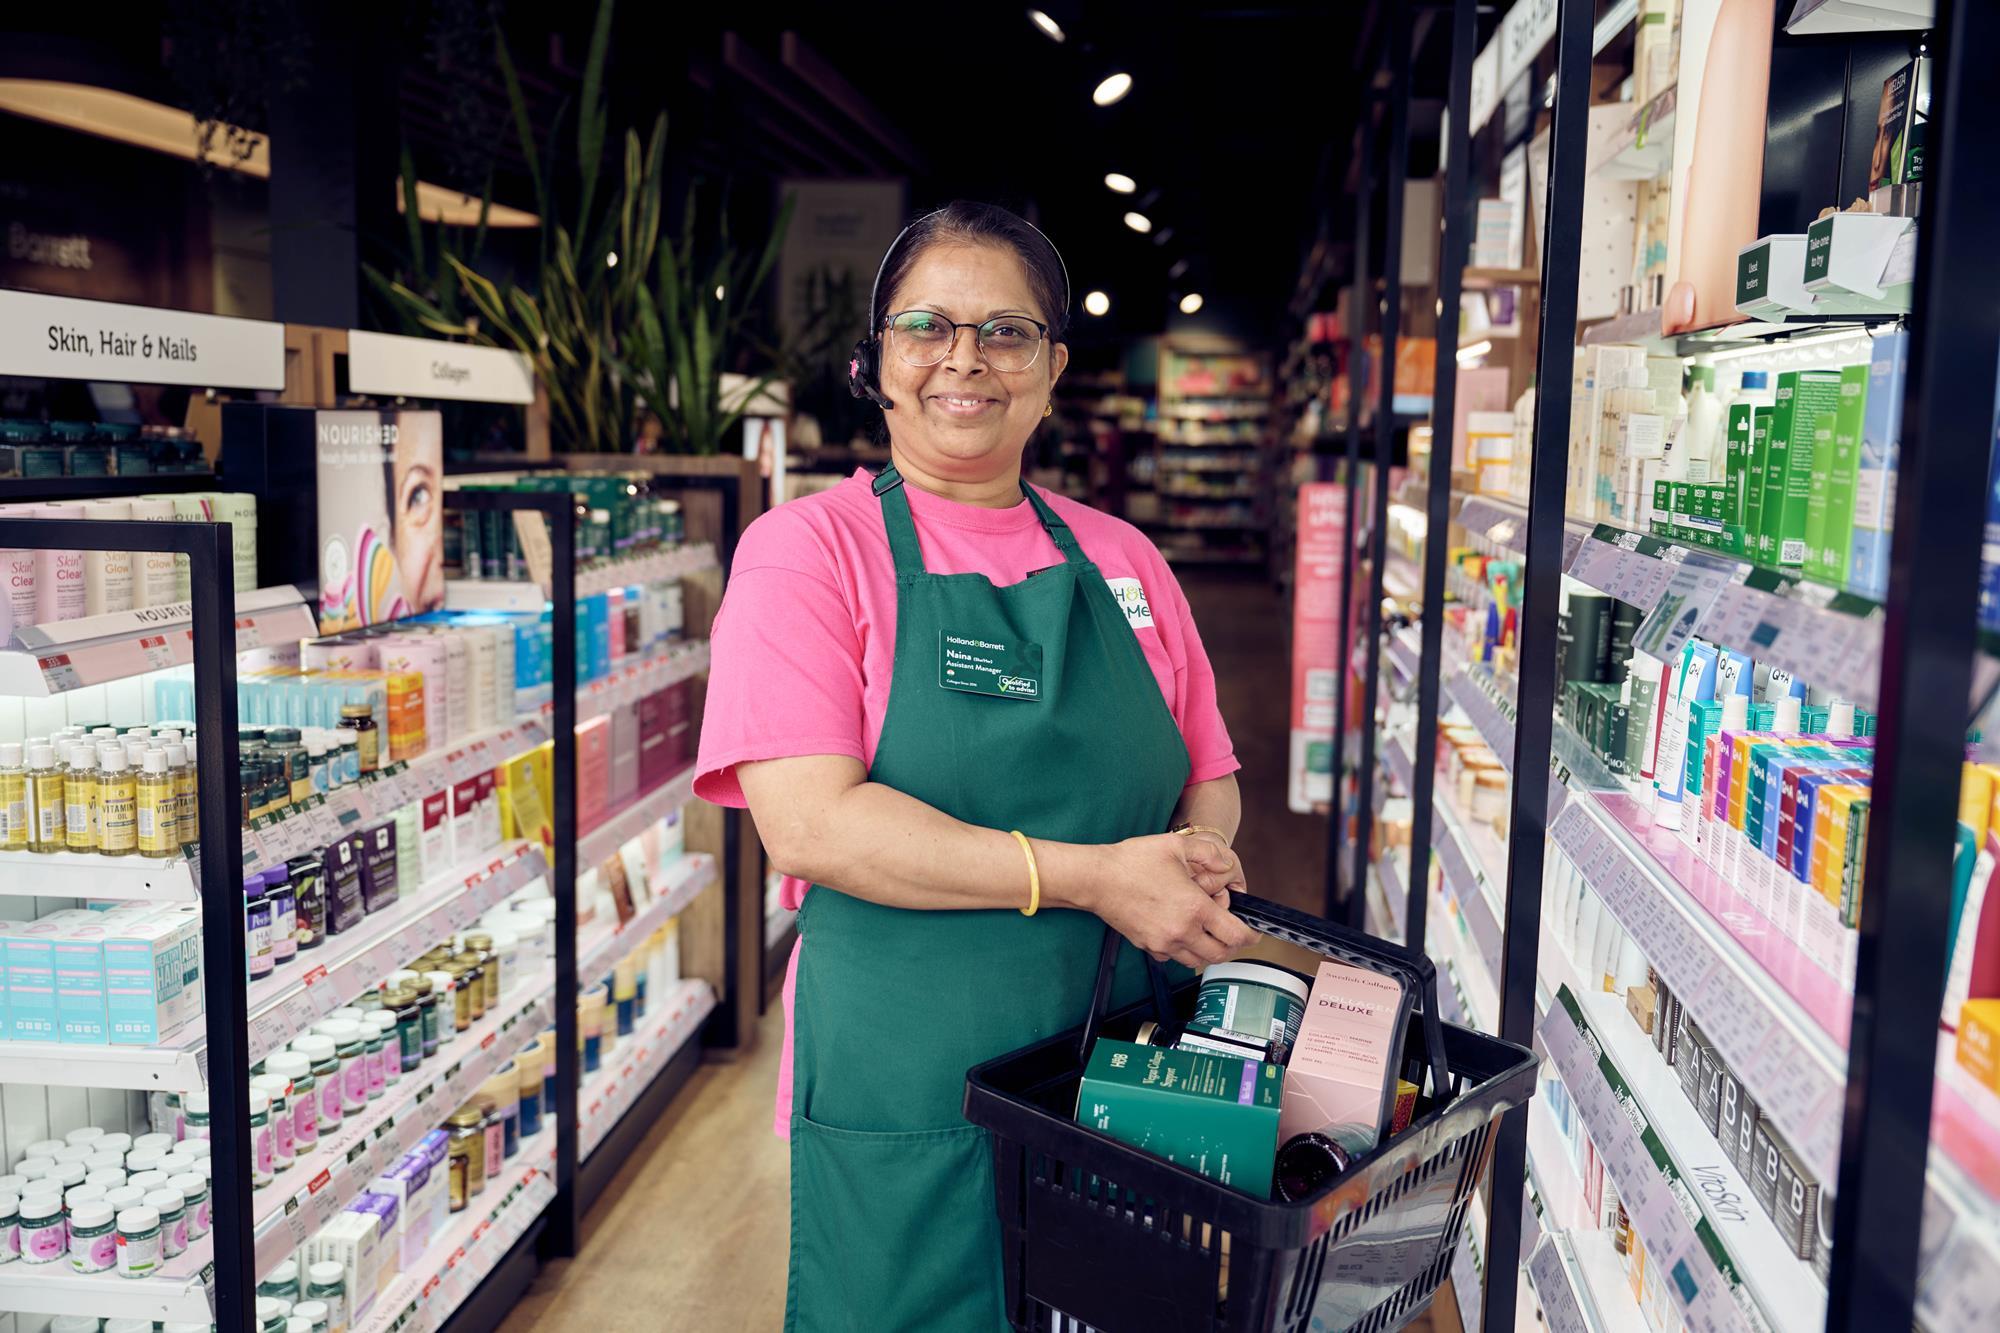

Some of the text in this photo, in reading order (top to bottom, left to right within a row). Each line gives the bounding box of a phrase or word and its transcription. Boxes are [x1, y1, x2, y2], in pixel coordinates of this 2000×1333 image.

[1913, 156, 1923, 164] Try
[9, 222, 93, 270] Barrett
[1810, 236, 1830, 251] Take one
[1748, 260, 1758, 273] Used
[1811, 257, 1817, 267] to
[1746, 279, 1759, 290] testers
[48, 326, 197, 362] Skin, Hair & Nails
[319, 424, 399, 445] NOURISHED
[105, 563, 129, 574] Glow
[147, 559, 171, 570] Glow
[12, 577, 34, 587] Clear
[57, 570, 82, 580] Clear
[1127, 605, 1150, 619] Me
[946, 635, 1005, 651] Holland&Barrett
[946, 649, 972, 661] Naina
[946, 660, 1002, 675] Assistant Manager
[1002, 677, 1030, 688] Qualified
[1772, 668, 1789, 684] Q+A
[1782, 781, 1794, 799] Q+A
[102, 803, 134, 814] VITAMIN
[181, 935, 197, 962] AIR
[157, 960, 182, 990] HAIR
[1326, 972, 1399, 992] Swedish Collagen
[1319, 1000, 1374, 1016] DELUXE
[1320, 992, 1394, 1014] COLLAGEN
[1691, 1047, 1699, 1077] A
[1709, 1071, 1719, 1103] A
[1724, 1077, 1737, 1126] B
[1739, 1111, 1751, 1152] B
[1766, 1145, 1779, 1182] B
[1791, 1176, 1804, 1215] B
